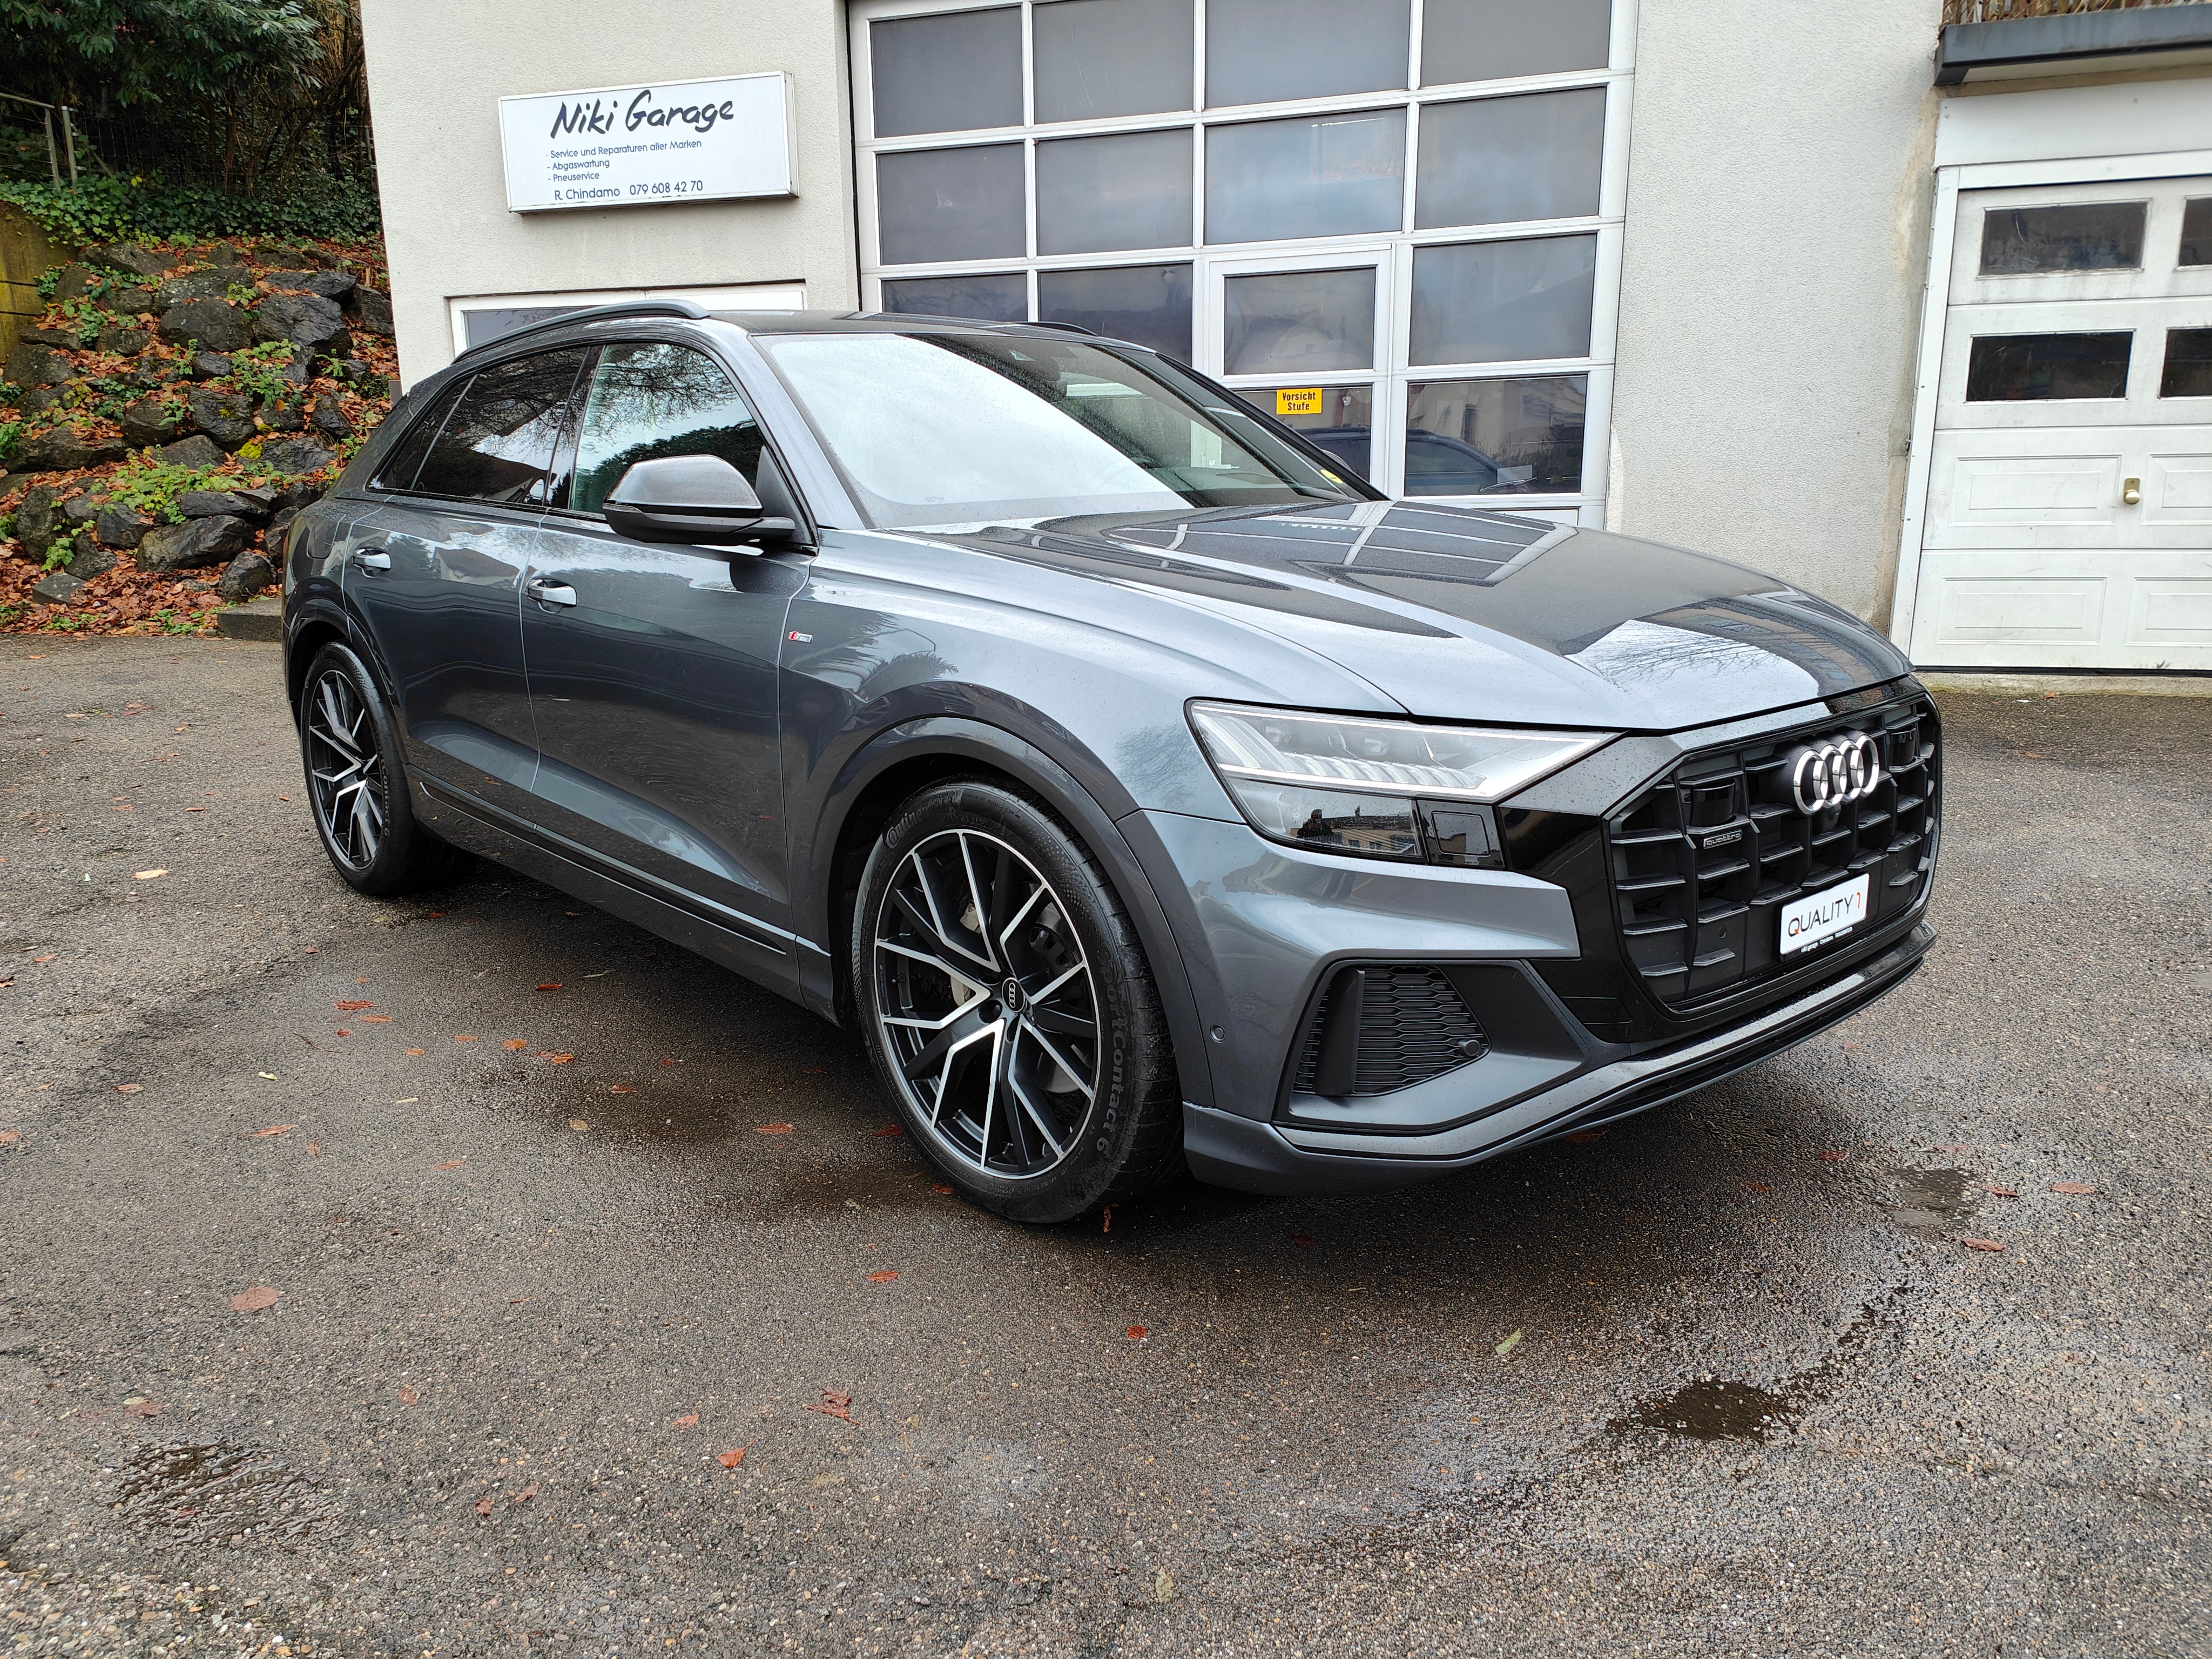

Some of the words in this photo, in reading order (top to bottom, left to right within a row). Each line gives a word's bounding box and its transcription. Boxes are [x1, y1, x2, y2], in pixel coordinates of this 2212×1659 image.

[550, 98, 618, 139] Niki
[625, 90, 734, 133] Garage
[550, 149, 578, 158] Service
[581, 147, 596, 156] und
[598, 144, 648, 156] Reparaturen
[650, 142, 667, 151] aller
[670, 139, 702, 150] Marken
[552, 159, 610, 171] Abgaswartung
[553, 172, 599, 182] Pneuservice
[555, 190, 563, 200] R.
[565, 187, 620, 200] Chindamo
[630, 184, 649, 195] 079
[651, 182, 671, 194] 608
[674, 181, 687, 192] 42
[690, 180, 703, 192] 70
[1282, 392, 1316, 401] Vorsicht
[1287, 402, 1310, 410] Stufe
[1706, 832, 1741, 846] quattro
[1788, 894, 1854, 938] QUALITY
[1856, 892, 1861, 909] 1
[1096, 1137, 1110, 1153] 6
